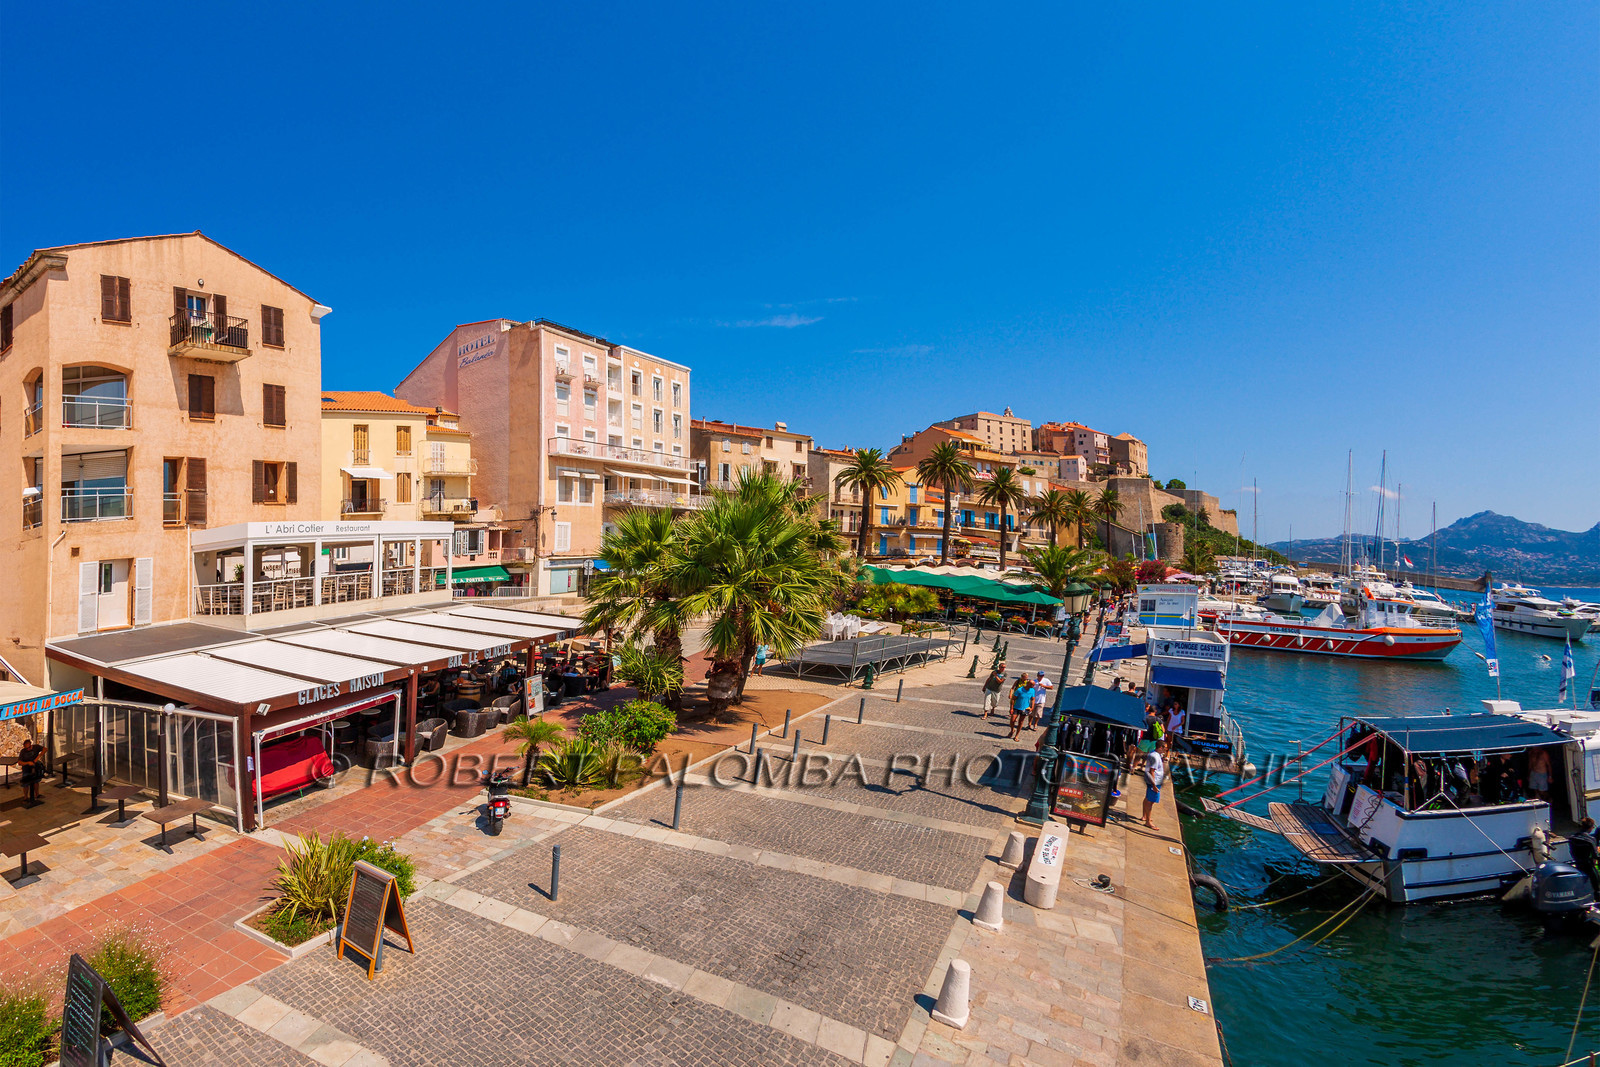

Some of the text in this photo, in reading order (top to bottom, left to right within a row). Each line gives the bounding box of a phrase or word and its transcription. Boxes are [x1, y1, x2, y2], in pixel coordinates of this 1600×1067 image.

[458, 334, 495, 356] HOTEL
[275, 524, 295, 534] Abri
[335, 524, 371, 533] Restaurant
[448, 643, 512, 669] BAR LE GLACIER
[1200, 644, 1225, 653] CASTILLE
[298, 672, 385, 706] GLACES MAISON
[12, 700, 38, 716] SALTI
[41, 697, 52, 710] IN
[54, 690, 83, 706] BOCCA
[1192, 740, 1229, 750] SCUBAPRO
[1552, 890, 1575, 898] YAMAHA
